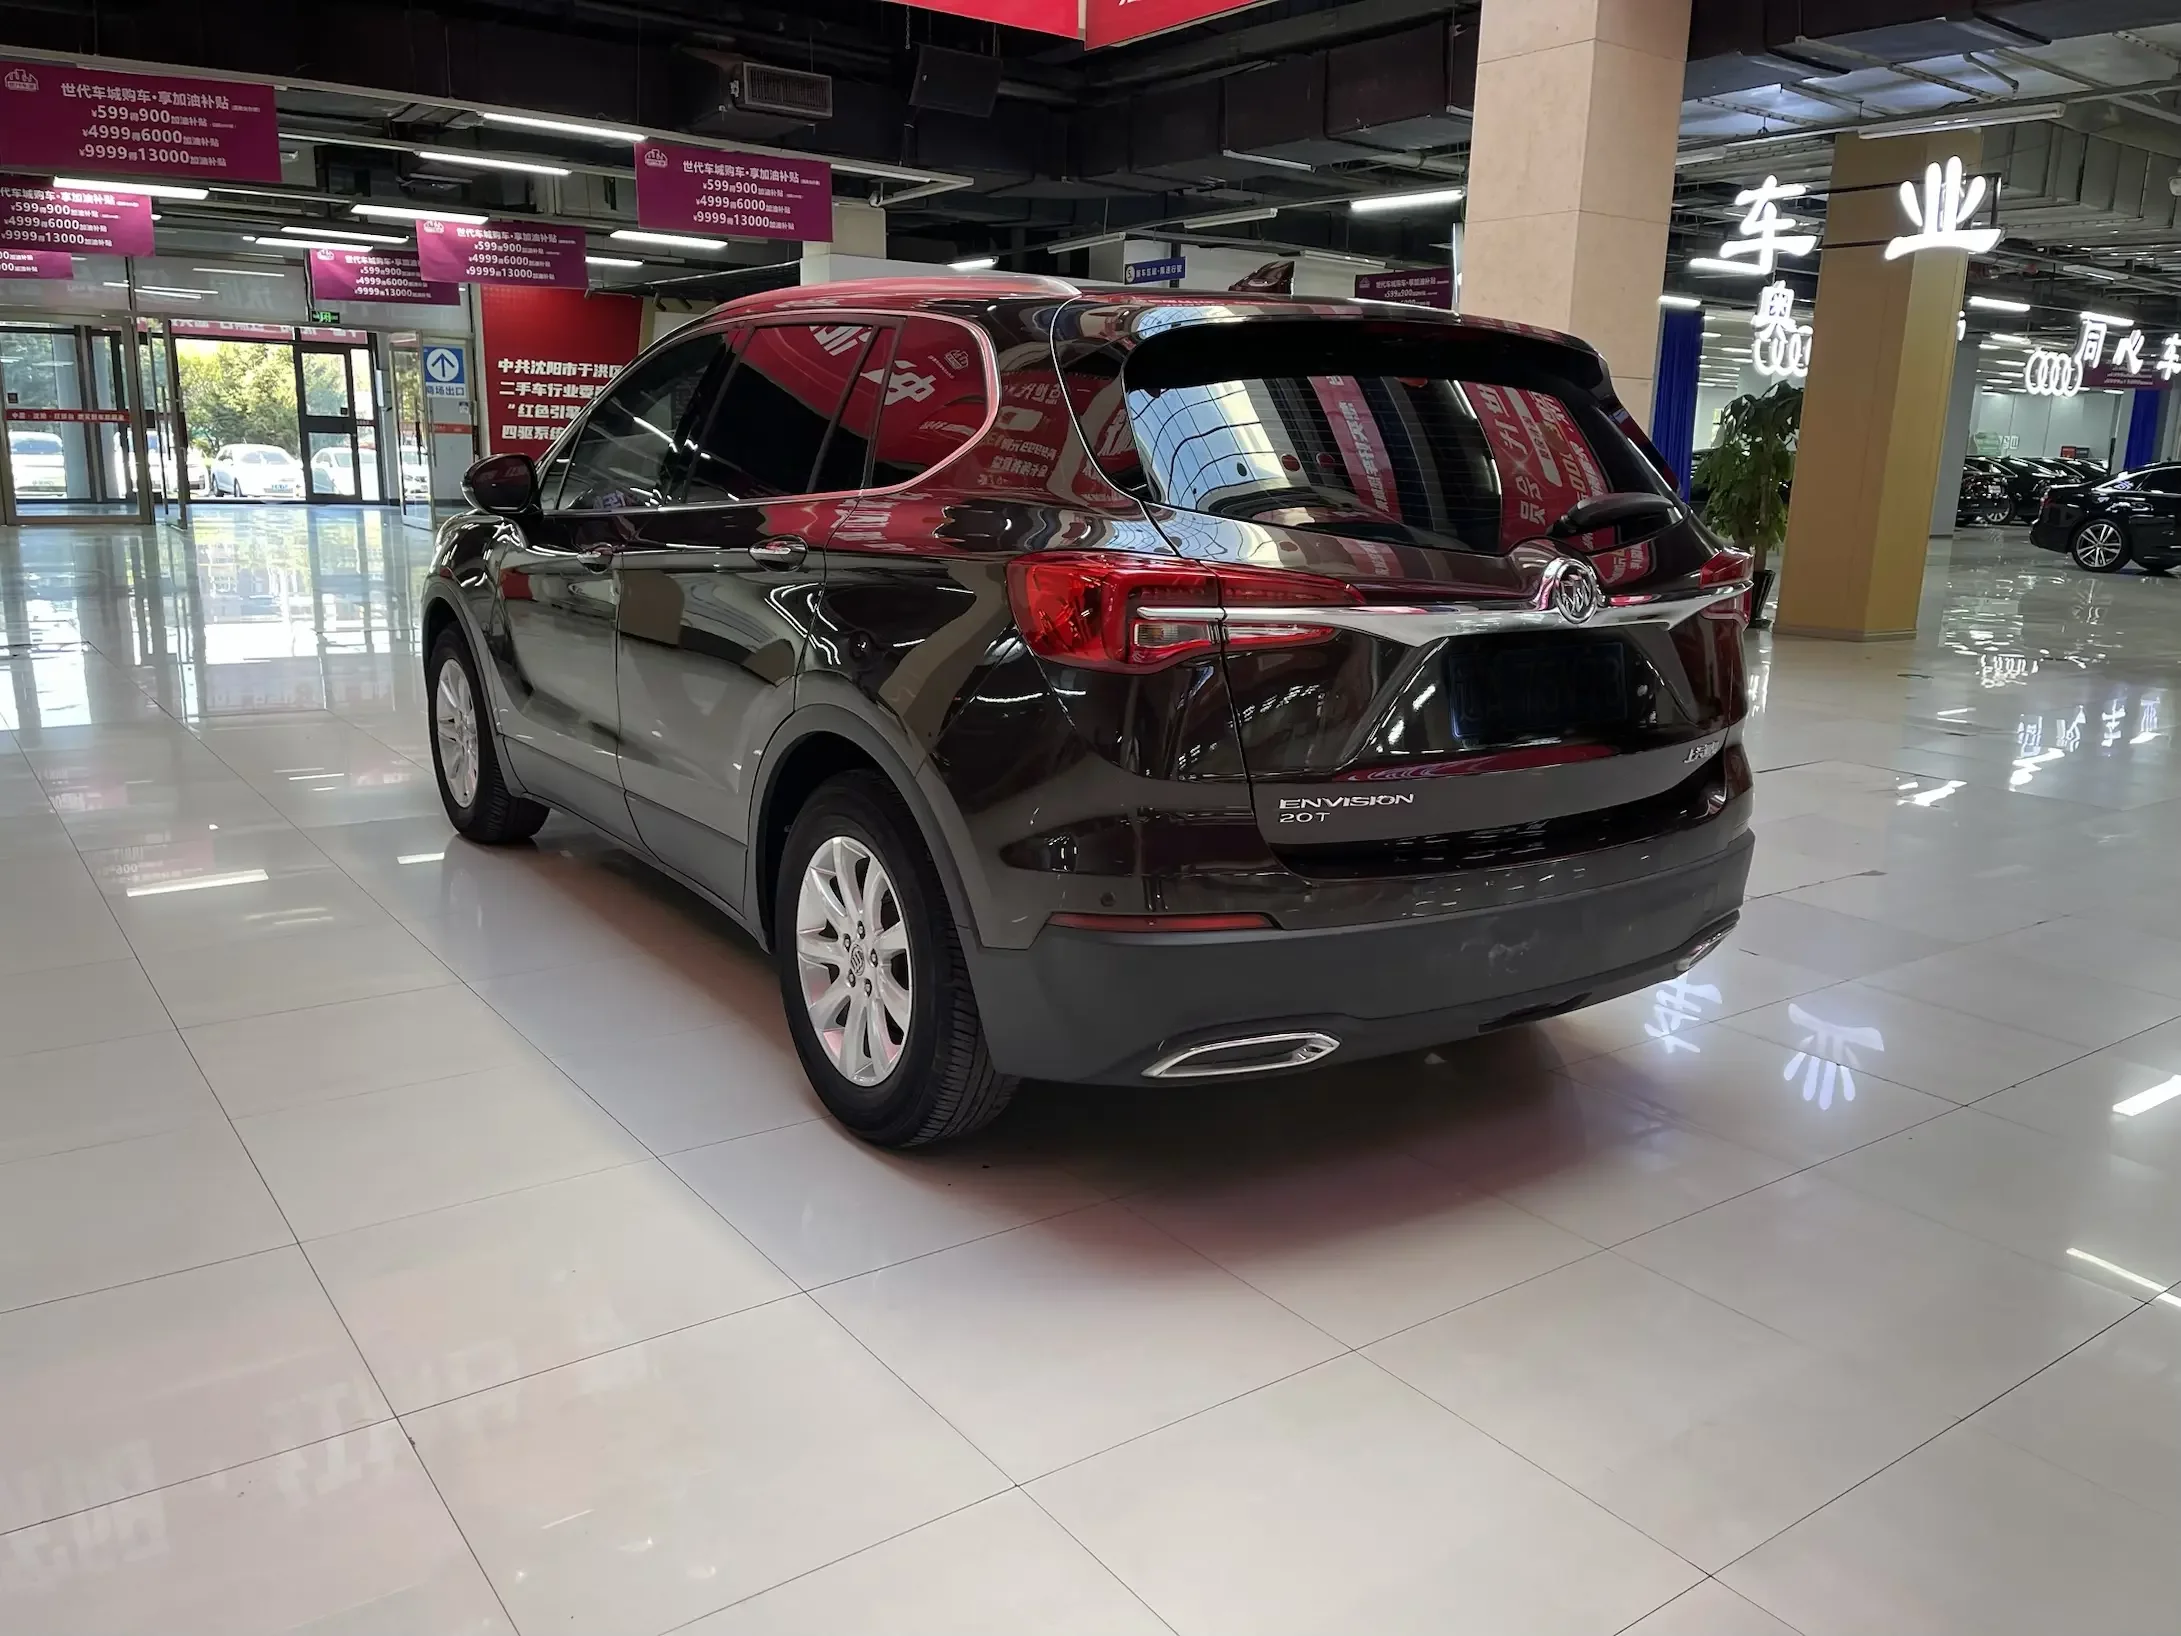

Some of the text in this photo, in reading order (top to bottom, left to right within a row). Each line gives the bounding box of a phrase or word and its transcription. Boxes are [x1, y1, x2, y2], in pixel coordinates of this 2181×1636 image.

[61, 83, 229, 110] 世代车城购车·享加油补贴
[683, 160, 799, 183] 世代车城购车·享加油补贴
[498, 358, 623, 378] 中共沈阳市于洪区
[1279, 793, 1414, 809] ENVISION
[1279, 812, 1330, 823] 20T
